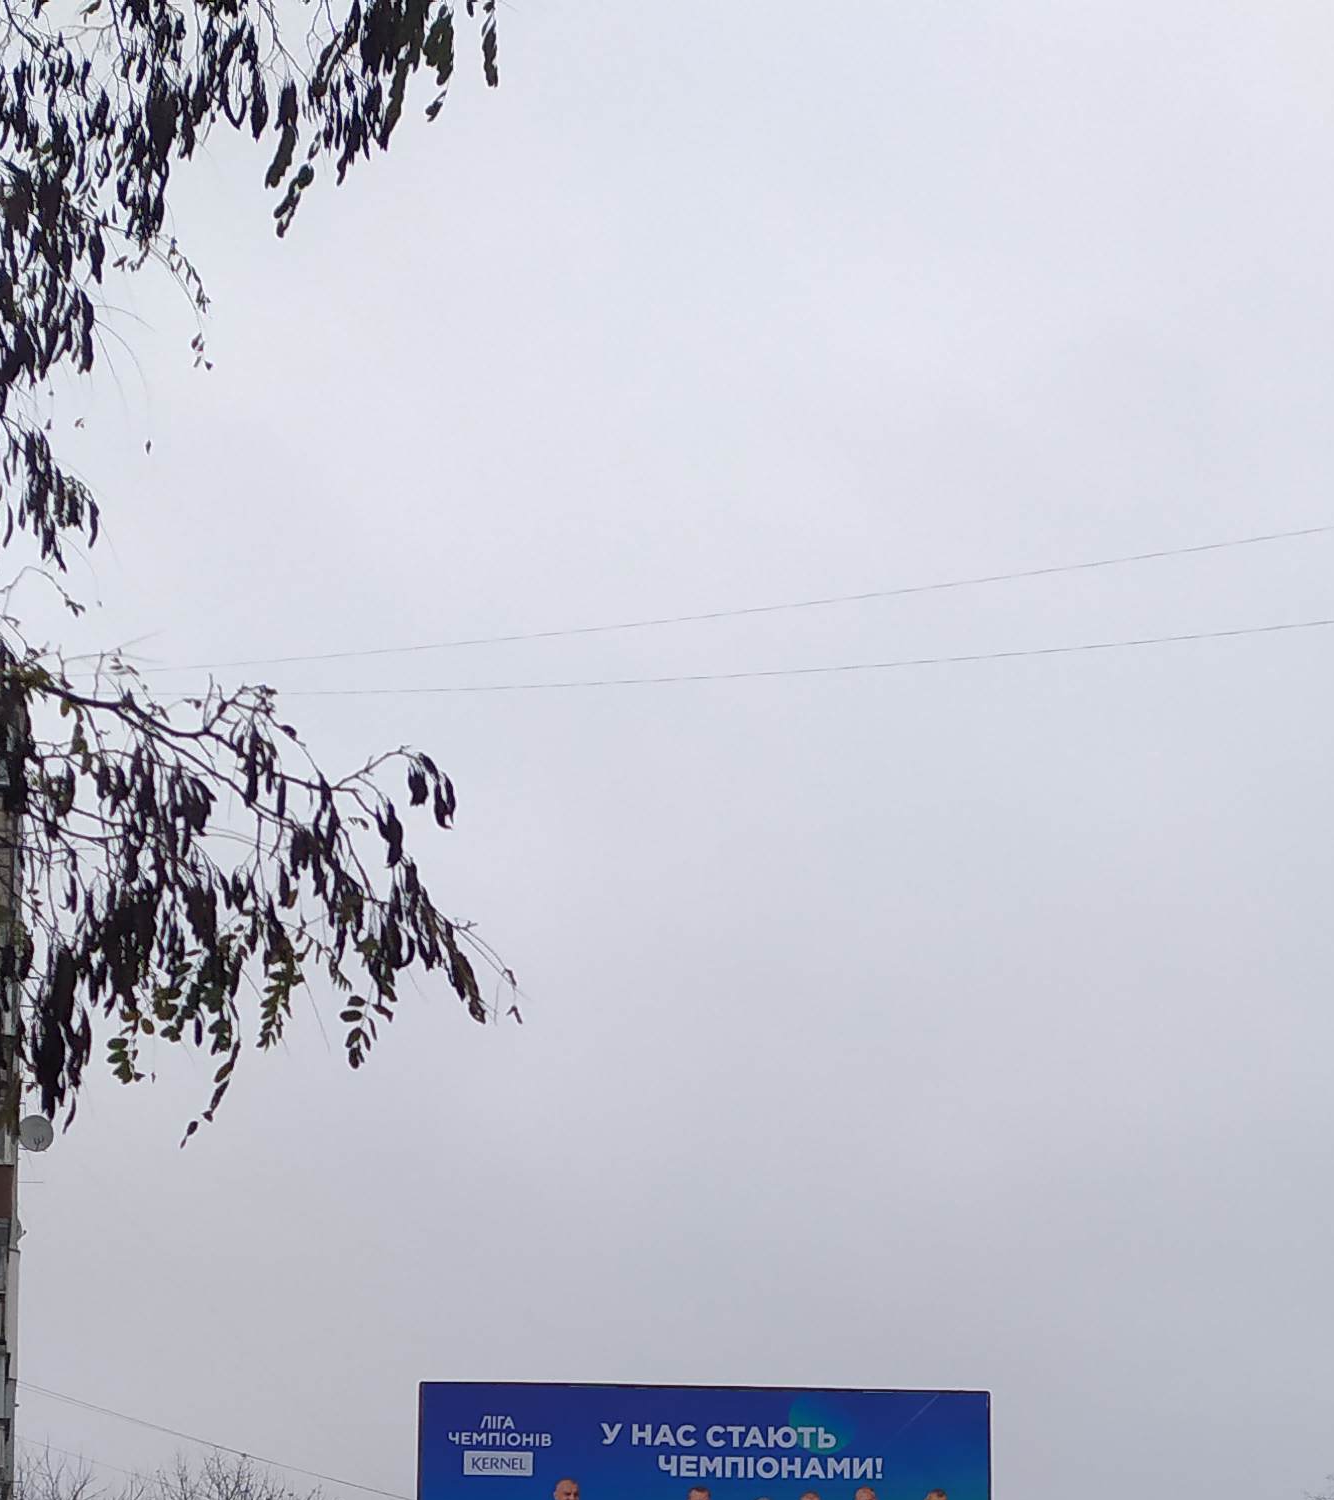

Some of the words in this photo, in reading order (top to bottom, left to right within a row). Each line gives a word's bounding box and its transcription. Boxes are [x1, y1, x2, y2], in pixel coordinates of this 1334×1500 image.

[480, 1415, 516, 1430] ЛІГА
[448, 1431, 552, 1448] ЧЕМПІОНІВ
[601, 1423, 623, 1446] У
[631, 1424, 697, 1447] НАС
[705, 1425, 837, 1449] СТАЮТЬ
[470, 1456, 527, 1472] KERNEL
[658, 1456, 884, 1480] ЧЕМПІОНАМИ!
